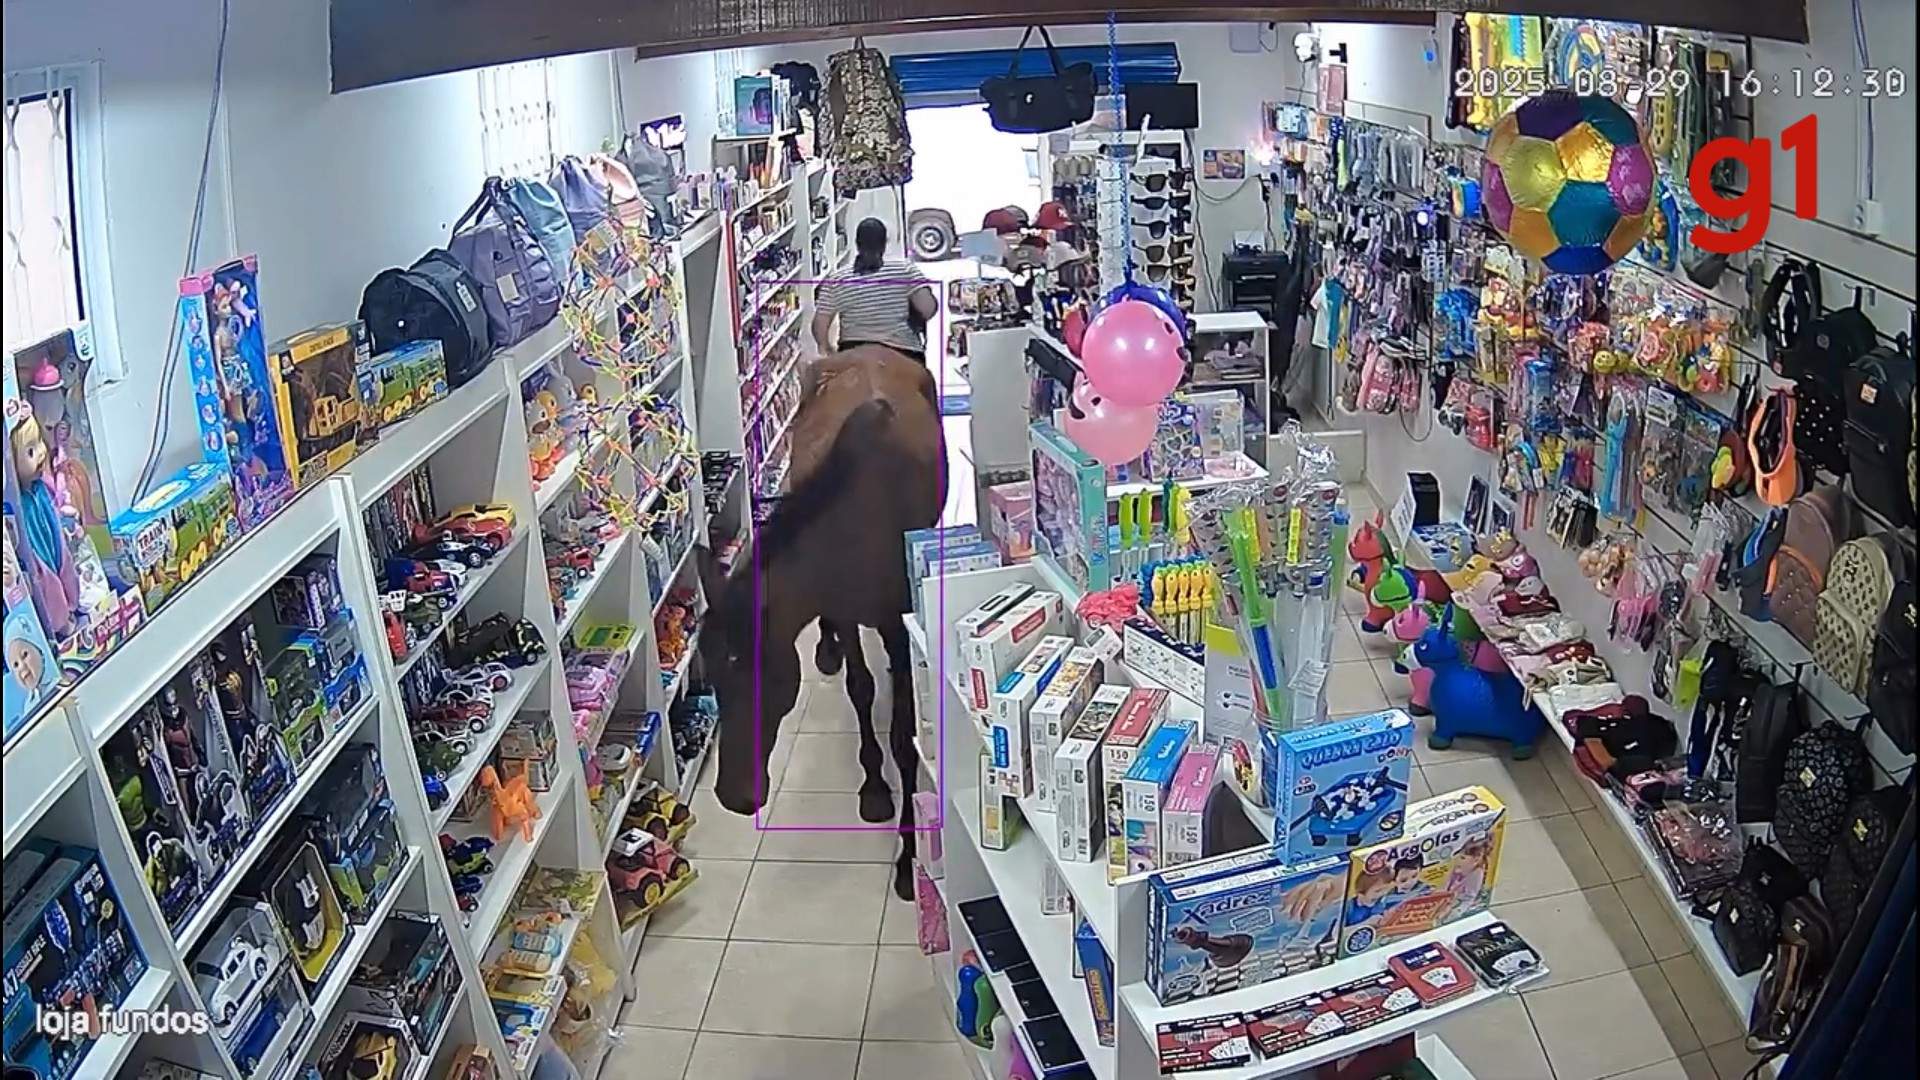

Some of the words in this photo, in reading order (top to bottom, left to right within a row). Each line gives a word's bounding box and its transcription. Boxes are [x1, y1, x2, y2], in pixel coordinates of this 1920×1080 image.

[1109, 749, 1129, 760] 150
[1144, 794, 1155, 812] 150
[1186, 825, 1198, 844] 150
